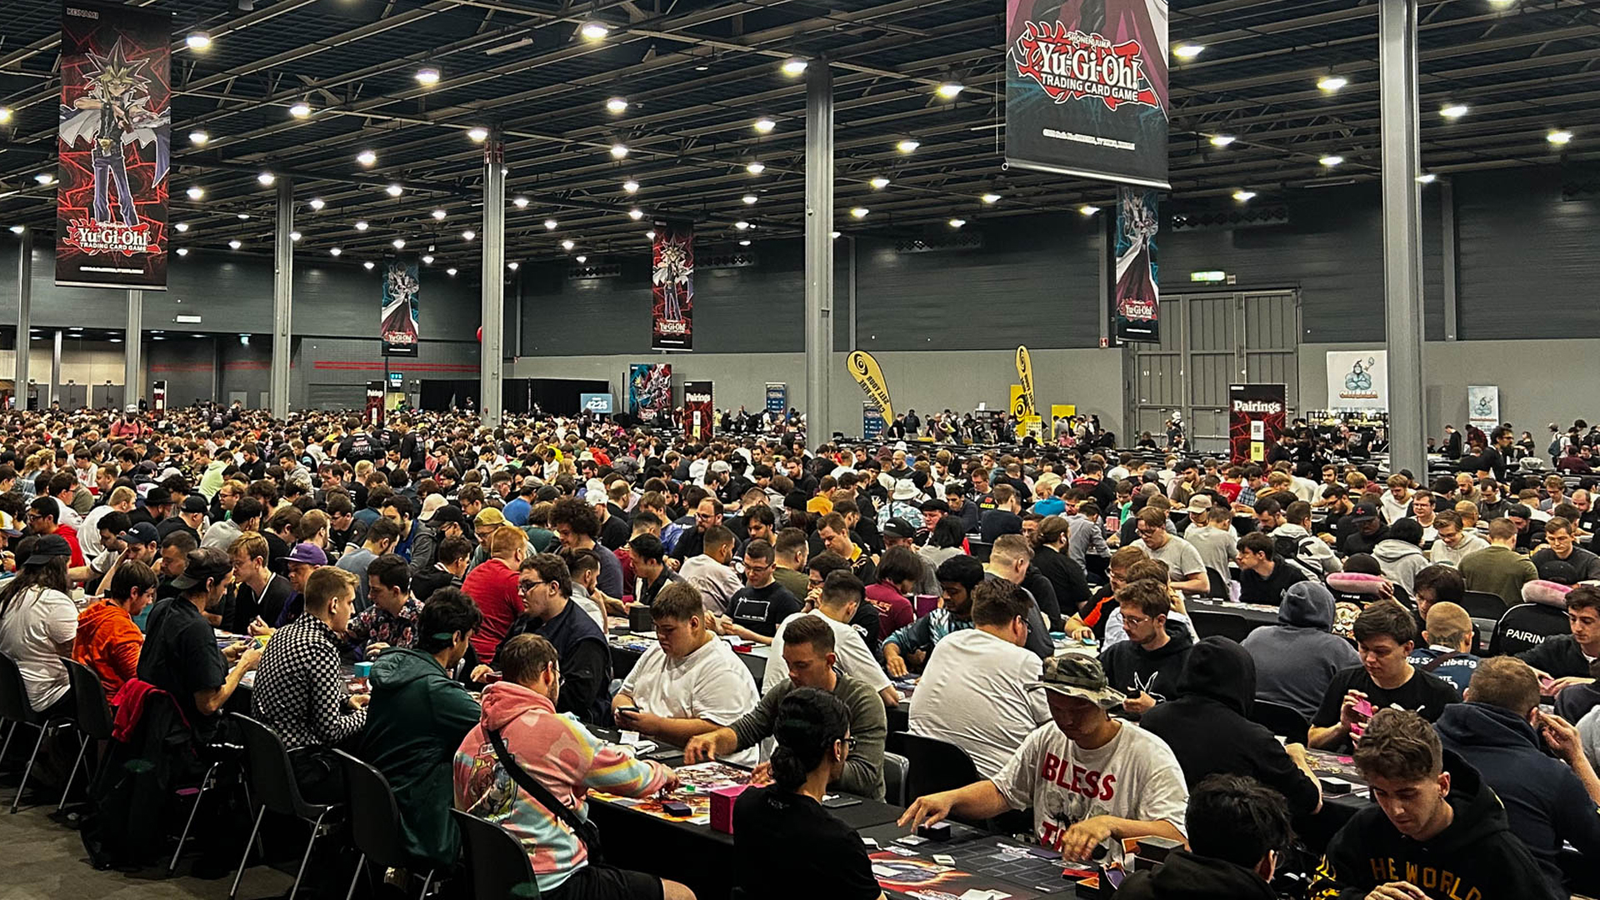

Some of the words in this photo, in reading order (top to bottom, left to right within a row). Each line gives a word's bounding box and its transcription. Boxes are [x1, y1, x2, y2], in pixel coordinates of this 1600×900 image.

[1037, 41, 1140, 90] Yu-Gi-Oh!
[1041, 73, 1083, 91] TRADING
[1084, 82, 1110, 97] CARD
[1111, 87, 1138, 102] GAME
[128, 244, 147, 252] GAME
[1233, 399, 1281, 414] Pairings
[1506, 628, 1546, 644] PAIRIN
[1042, 752, 1117, 801] BLESS
